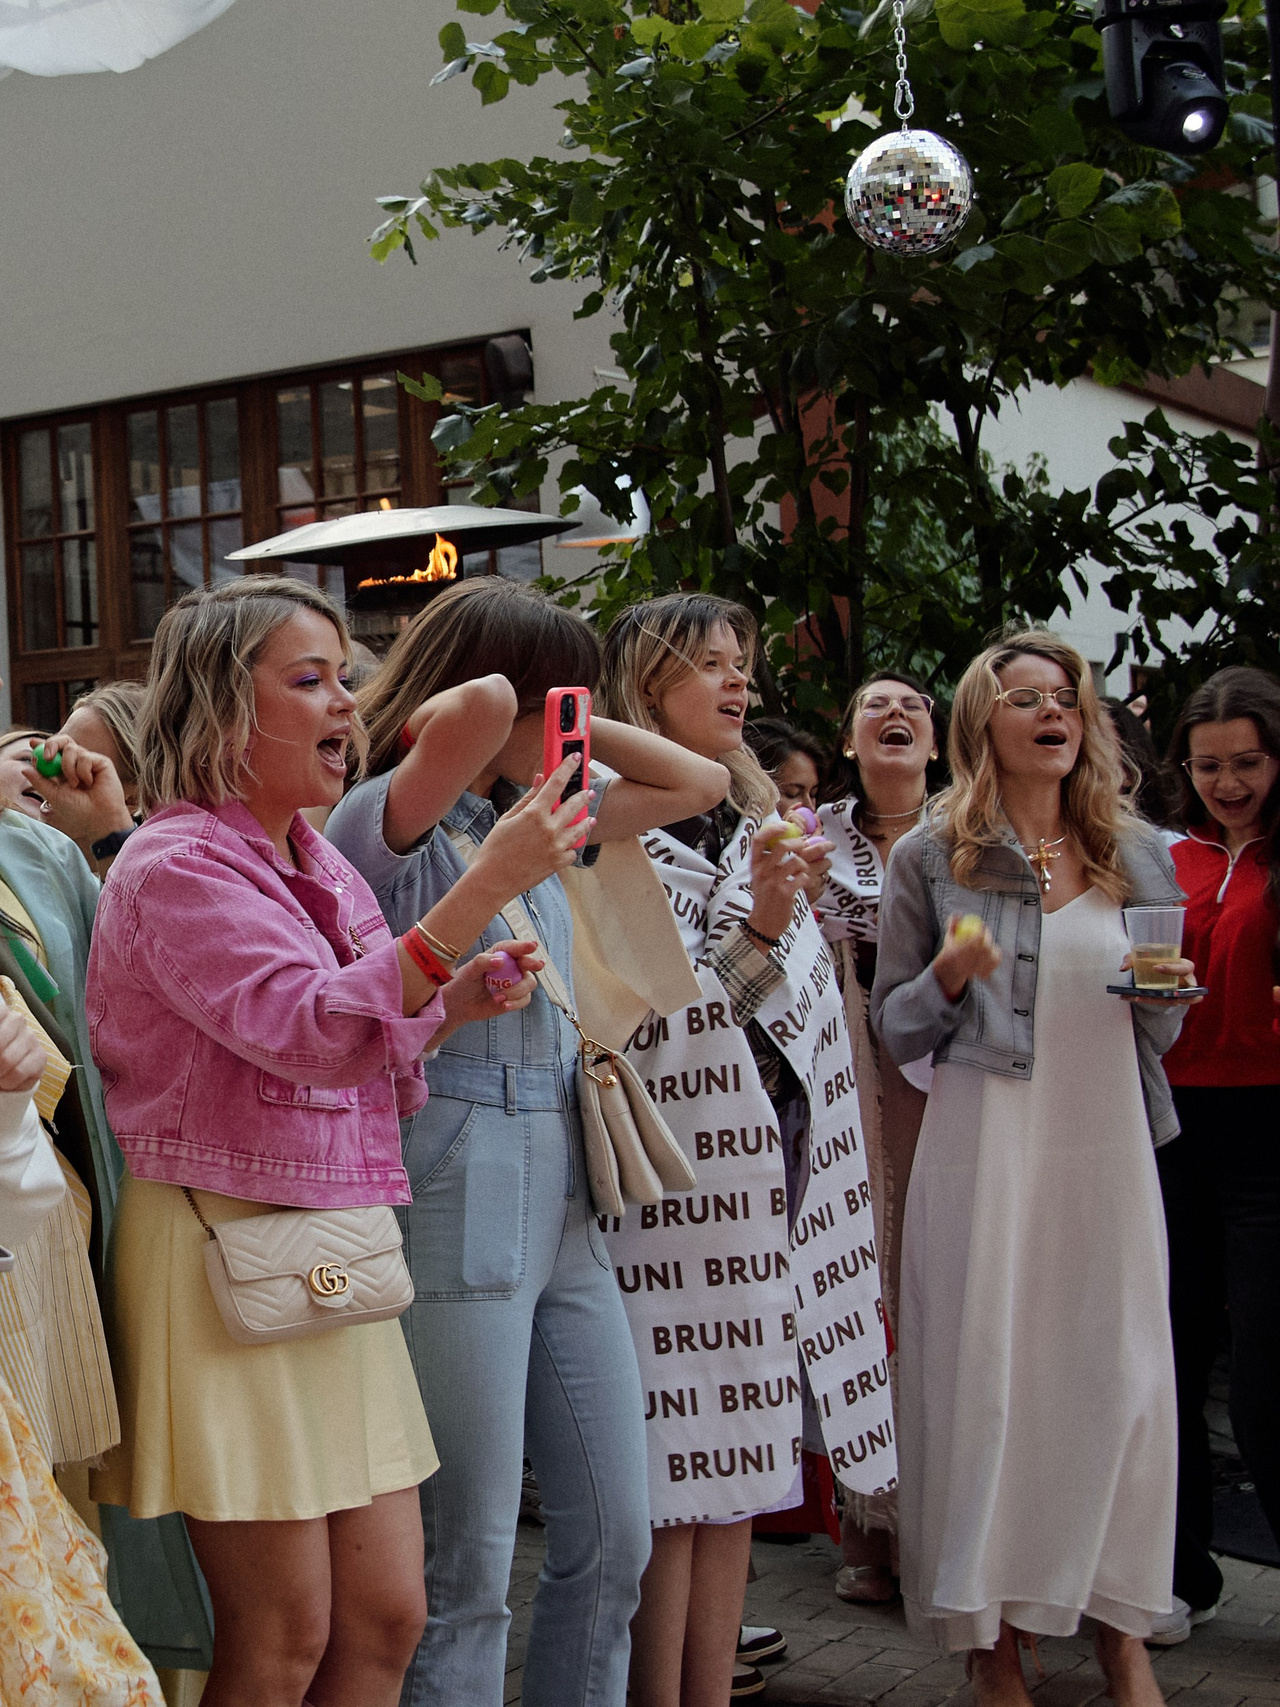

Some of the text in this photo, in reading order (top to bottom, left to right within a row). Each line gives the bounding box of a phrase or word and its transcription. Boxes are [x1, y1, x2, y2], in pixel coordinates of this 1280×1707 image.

[484, 976, 513, 989] ING
[812, 1126, 857, 1175] UNI
[641, 1191, 750, 1230] BRUNI
[791, 1202, 835, 1252] UNI
[652, 1318, 763, 1355] BRUNI
[668, 1444, 775, 1482] BRUNI
